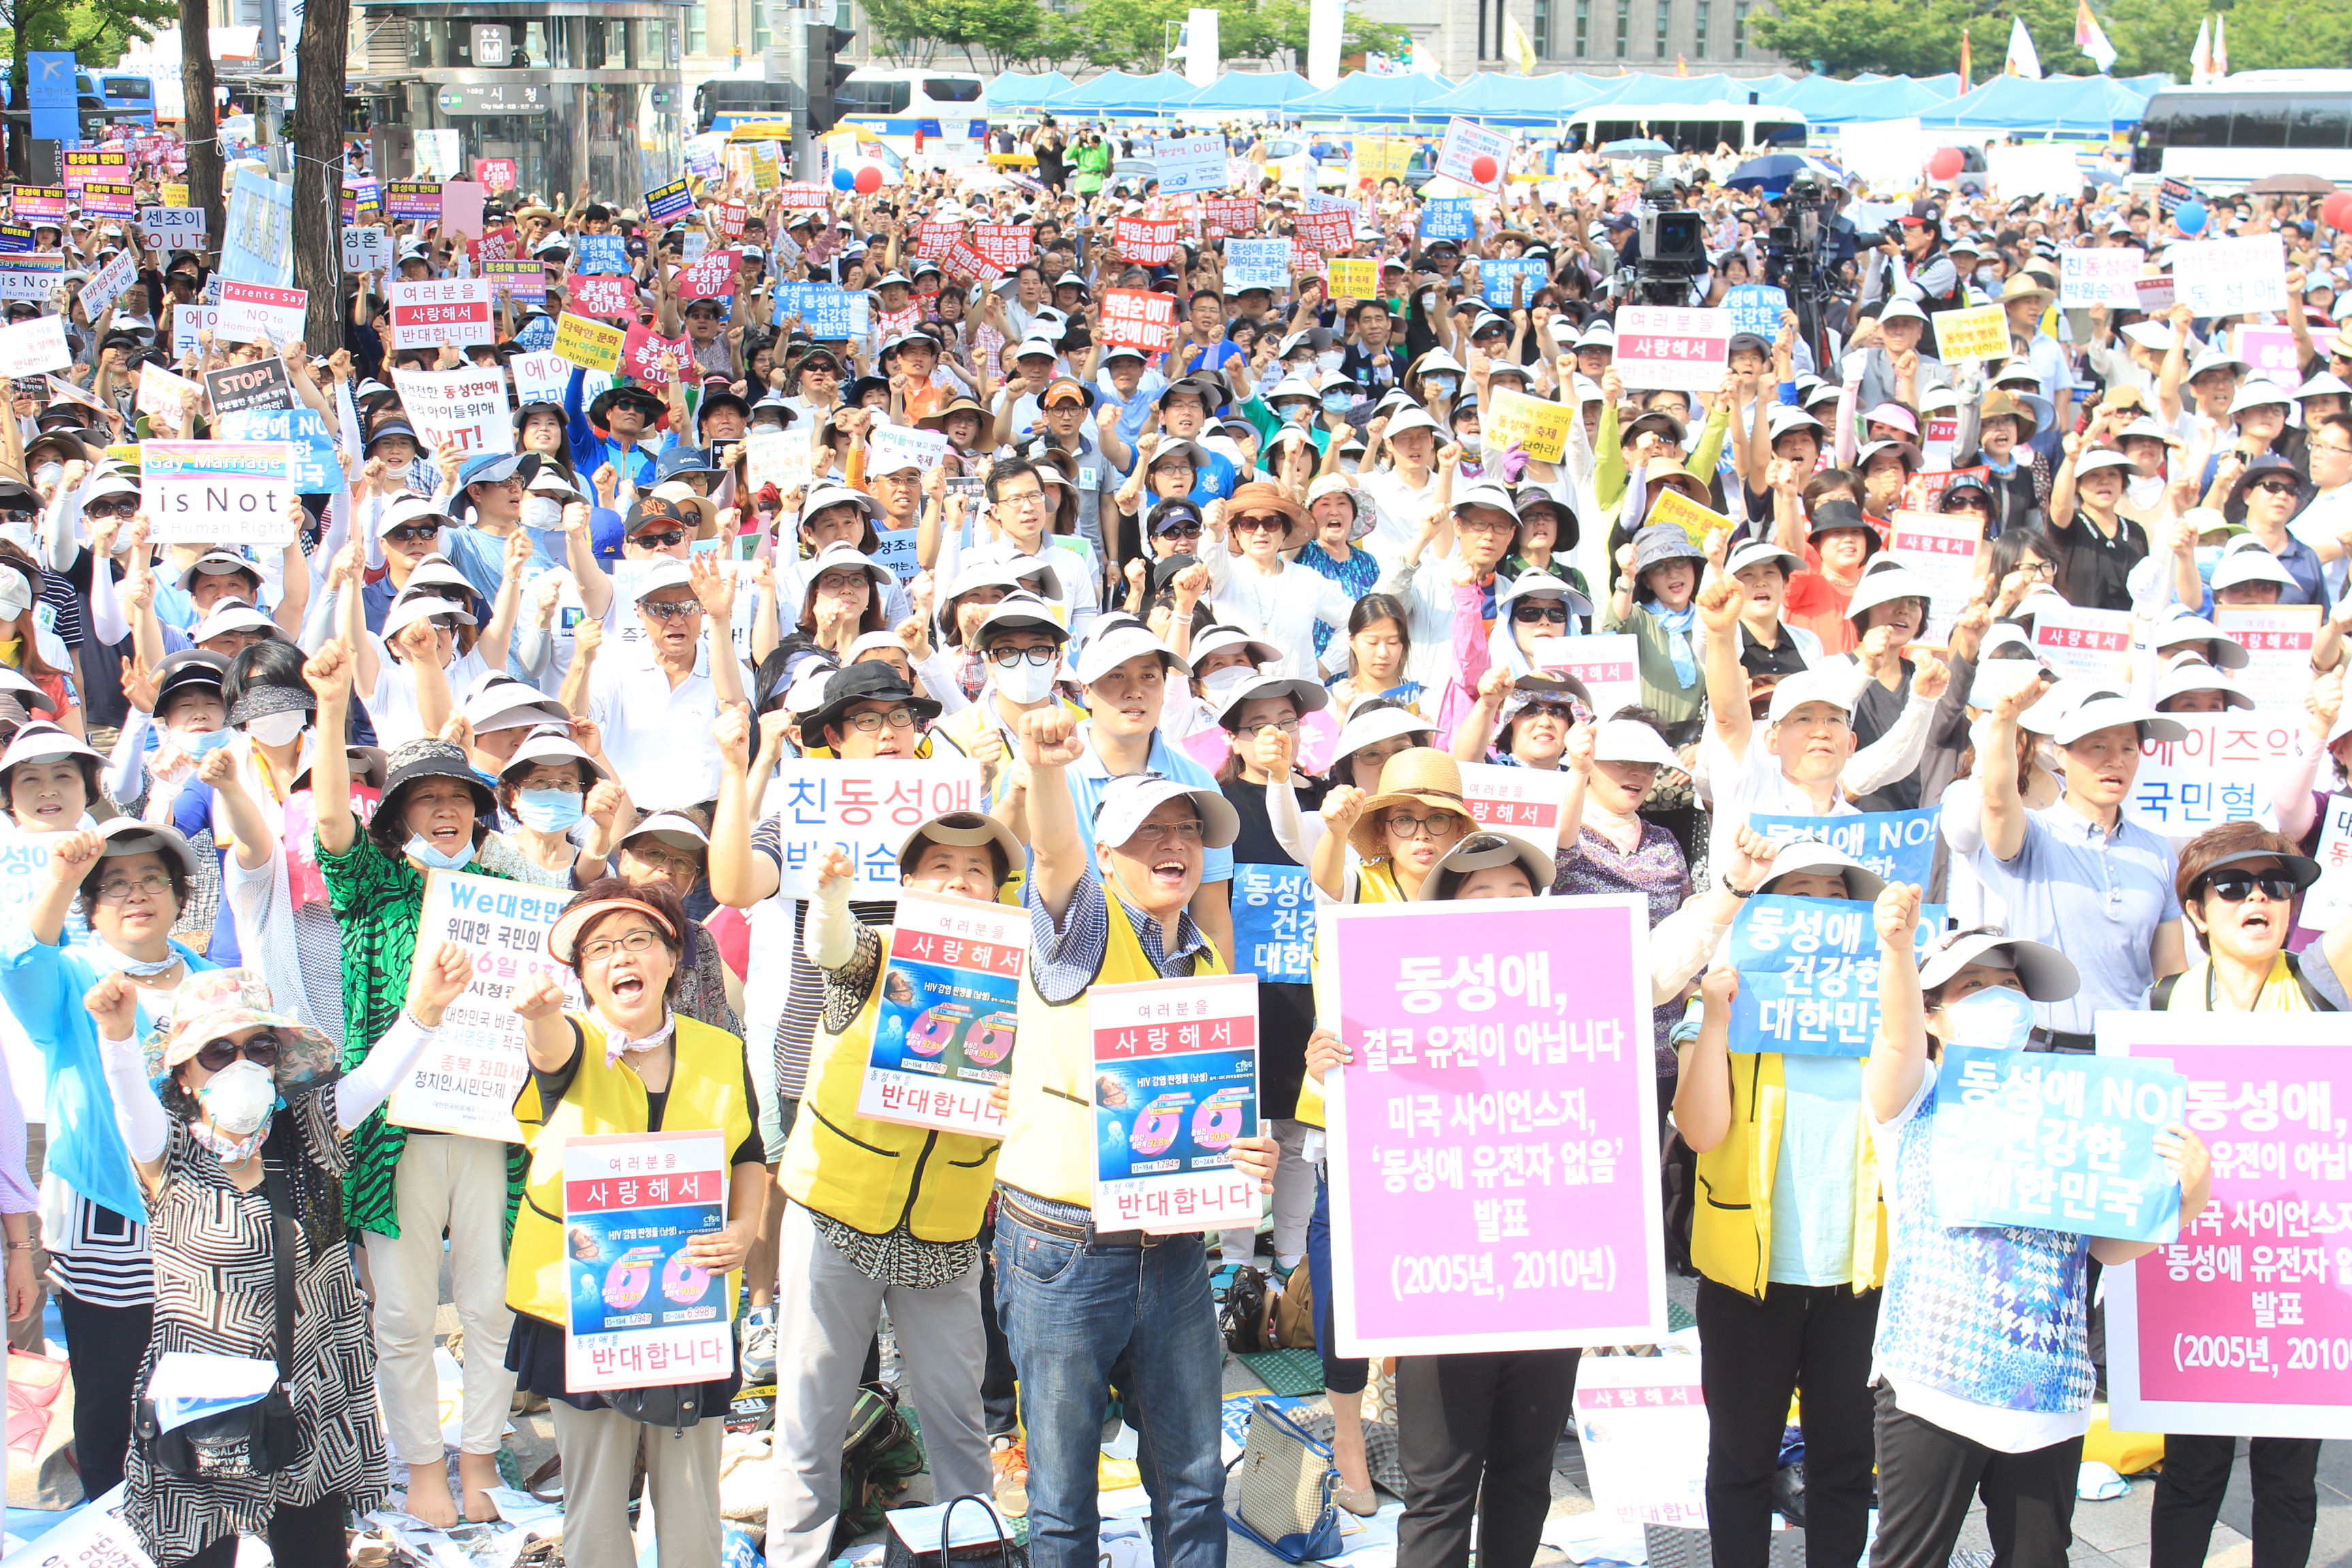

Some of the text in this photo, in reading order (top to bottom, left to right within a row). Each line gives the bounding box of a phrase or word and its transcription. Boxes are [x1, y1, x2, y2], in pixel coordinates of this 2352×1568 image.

[1193, 142, 1220, 153] OUT
[68, 153, 124, 165] 동성애 반대!
[16, 187, 63, 197] 동성애 반대!
[86, 184, 131, 195] 동성애 반대!
[391, 184, 439, 194] 동성애 반대!
[1424, 200, 1454, 213] 동성애
[146, 210, 201, 229] 센조이
[1433, 212, 1463, 225] 건강한
[2, 227, 31, 238] QUEER!
[922, 224, 942, 233] 동성애
[977, 227, 1030, 235] 동성애 홍보대사
[1118, 221, 1177, 243] 박원순 OUT
[1297, 222, 1349, 240] 박원순을
[1427, 223, 1467, 236] 대한민국
[148, 233, 203, 248] OUT
[477, 235, 505, 252] 동성애
[580, 238, 608, 251] 동성애
[977, 236, 1030, 251] 박원순을
[1230, 242, 1286, 256] 동성애 조장
[589, 250, 617, 263] 건강한
[952, 243, 983, 274] 박원순
[1119, 241, 1175, 262] 동성애 OUT
[2183, 246, 2276, 274] 바텀알바
[19, 259, 61, 270] Marriage
[485, 263, 540, 272] 동성애 반대!
[586, 261, 622, 273] 대한민국
[694, 255, 729, 270] 동성애
[1229, 255, 1286, 269] 에이즈 확산
[1484, 262, 1548, 277] 동성애 NO!
[2064, 256, 2138, 277] 친동성애
[23, 275, 59, 289] Not
[85, 255, 130, 300] 바텀알바
[585, 280, 621, 293] 동성애
[1234, 270, 1281, 284] 세금폭탄
[1354, 274, 1369, 284] 축제
[227, 285, 304, 306] Parents Say
[404, 284, 476, 301] 여러분을
[578, 289, 627, 308] 동성결혼
[696, 282, 721, 297] OUT
[1329, 286, 1341, 294] 즉각
[2189, 277, 2276, 310] 동성애
[588, 301, 617, 314] OUT
[804, 294, 840, 309] 동성애
[1105, 293, 1173, 323] 박원순 OUT
[274, 316, 283, 324] to
[411, 306, 472, 323] 사랑해서
[1631, 312, 1714, 333] 여러분을
[402, 327, 484, 343] 반대합니다!
[563, 321, 619, 347] 타락한 문화
[1101, 317, 1143, 343] 동성애
[555, 336, 617, 361] 속에서 아이들을
[1635, 338, 1707, 358] 사랑해서
[568, 351, 600, 368] 지켜내자!
[218, 367, 274, 395] STOP!
[444, 380, 499, 399] 동성연애
[216, 388, 287, 412] 무분별한 동성애 행위
[427, 402, 495, 419] 아이들위해
[1535, 411, 1572, 425] 보고 있다!
[1499, 414, 1558, 440] 동성애 축제
[877, 430, 944, 452] 아이들이 보고 있다!
[1488, 429, 1508, 445] 즉각
[148, 453, 281, 474] Gay Marriage
[917, 454, 934, 467] 축제
[161, 487, 278, 513] is Not
[1663, 499, 1699, 526] 타락한
[172, 521, 286, 537] Human Right
[1906, 538, 1963, 553] 사랑해서
[2245, 619, 2287, 628] 여러분을
[2049, 630, 2118, 651] 사랑해서
[787, 777, 971, 826] 친동성애
[1879, 812, 1940, 852] NO!
[446, 917, 541, 953] 위대한 국민의
[940, 917, 1005, 940] 여러분을
[1747, 906, 1863, 954] 동성애
[911, 936, 1021, 975] 사랑해서
[924, 981, 990, 1002] HIV 감염 판정률 (남성)
[1395, 951, 1567, 1015] 동성애,
[1139, 999, 1209, 1019] 여러분을
[445, 1006, 517, 1032] 대한민국 바로
[502, 1034, 524, 1053] 적극
[1115, 1021, 1232, 1055] 사랑해서
[1362, 1018, 1624, 1072] 결코 유전이 아닙니다
[441, 1054, 471, 1074] 종북
[1137, 1077, 1151, 1088] HIV
[1152, 1075, 1166, 1087] 감염
[1167, 1073, 1189, 1085] 판정률
[1190, 1071, 1208, 1083] (남성)
[1957, 1059, 2184, 1125] 동성애 NO!
[1388, 1088, 1596, 1137] 미국 사이언스지,
[2186, 1080, 2348, 1139] 동성애,
[609, 1154, 677, 1172] 여러분을
[1471, 1142, 1554, 1191] 유전자
[2210, 1142, 2287, 1180] 유전이
[586, 1175, 700, 1207] 사랑해서
[1118, 1183, 1253, 1221] 반대합니다
[1473, 1198, 1530, 1243] 발표
[608, 1225, 677, 1241] HIV 감염 판정률 (남성)
[1391, 1245, 1616, 1303] (2005년, 2010년)
[2250, 1245, 2329, 1284] 유전자
[2252, 1290, 2304, 1328] 발표
[593, 1337, 723, 1375] 반대합니다
[2173, 1334, 2278, 1379] (2005년,
[1594, 1386, 1688, 1407] 사랑해서
